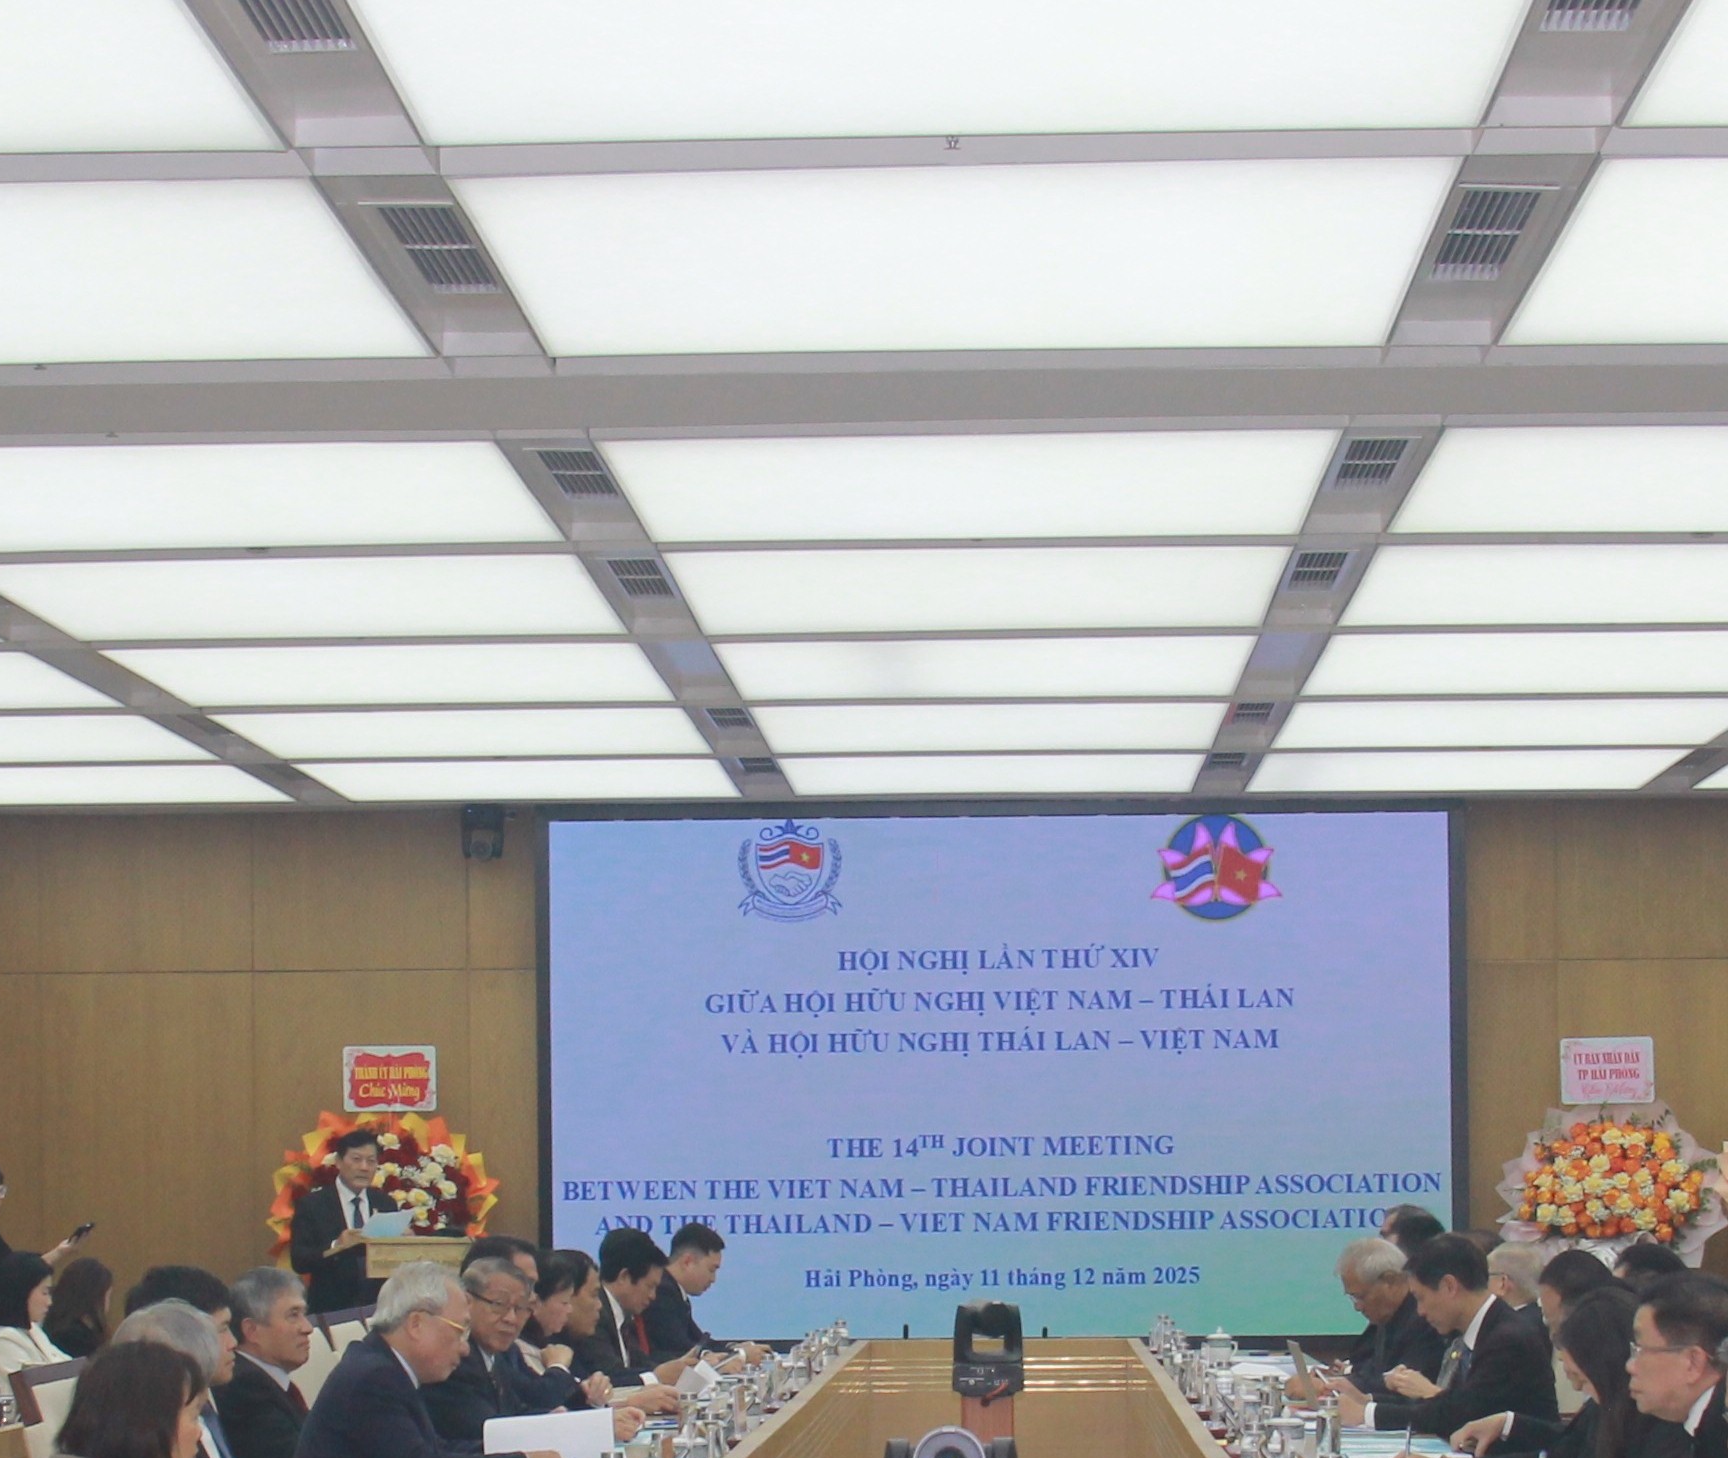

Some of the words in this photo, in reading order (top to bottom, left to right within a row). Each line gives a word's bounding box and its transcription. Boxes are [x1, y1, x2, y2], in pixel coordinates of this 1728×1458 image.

[838, 947, 889, 976] HỘI
[898, 949, 969, 975] NGHỊ
[979, 942, 1035, 970] LẦN
[1042, 944, 1105, 969] THỨ
[1110, 947, 1159, 969] XIV
[705, 989, 777, 1014] GIỮA
[784, 990, 836, 1018] HỘI
[845, 988, 905, 1012] HỮU
[914, 991, 985, 1016] NGHỊ
[993, 988, 1058, 1017] VIỆT
[1067, 990, 1132, 1010] NAM
[1160, 983, 1229, 1009] THÁI
[1238, 988, 1294, 1009] LAN
[721, 1029, 759, 1054] VÀ
[768, 1031, 819, 1058] HỘI
[827, 1028, 889, 1053] HỮU
[898, 1031, 969, 1057] NGHỊ
[978, 1026, 1045, 1051] THÁI
[1055, 1030, 1111, 1051] LAN
[1139, 1027, 1205, 1055] VIỆT
[1213, 1028, 1279, 1050] NAM
[827, 1138, 883, 1158] THE
[952, 1136, 1035, 1157] JOINT
[1042, 1135, 1174, 1156] MEETING
[562, 1180, 698, 1201] BETWEEN
[705, 1179, 760, 1200] THE
[767, 1178, 832, 1200] VIET
[839, 1178, 904, 1199] NAM
[931, 1176, 1077, 1198] THAILAND
[1084, 1175, 1250, 1197] FRIENDSHIP
[1255, 1172, 1442, 1195] ASSOCIATION
[595, 1214, 653, 1236] AND
[724, 1213, 872, 1235] THAILAND
[899, 1212, 965, 1233] VIET
[972, 1211, 1039, 1232] NAM
[1046, 1209, 1214, 1232] FRIENDSHIP
[1220, 1207, 1386, 1231] ASSOCIATIO
[805, 1268, 841, 1288] Hải
[848, 1268, 918, 1291] Phòng,
[925, 1268, 973, 1291] ngày
[980, 1269, 1000, 1287] 11
[1007, 1267, 1066, 1290] tháng
[1073, 1267, 1095, 1286] 12
[1102, 1266, 1146, 1286] năm
[1153, 1266, 1200, 1285] 2025
